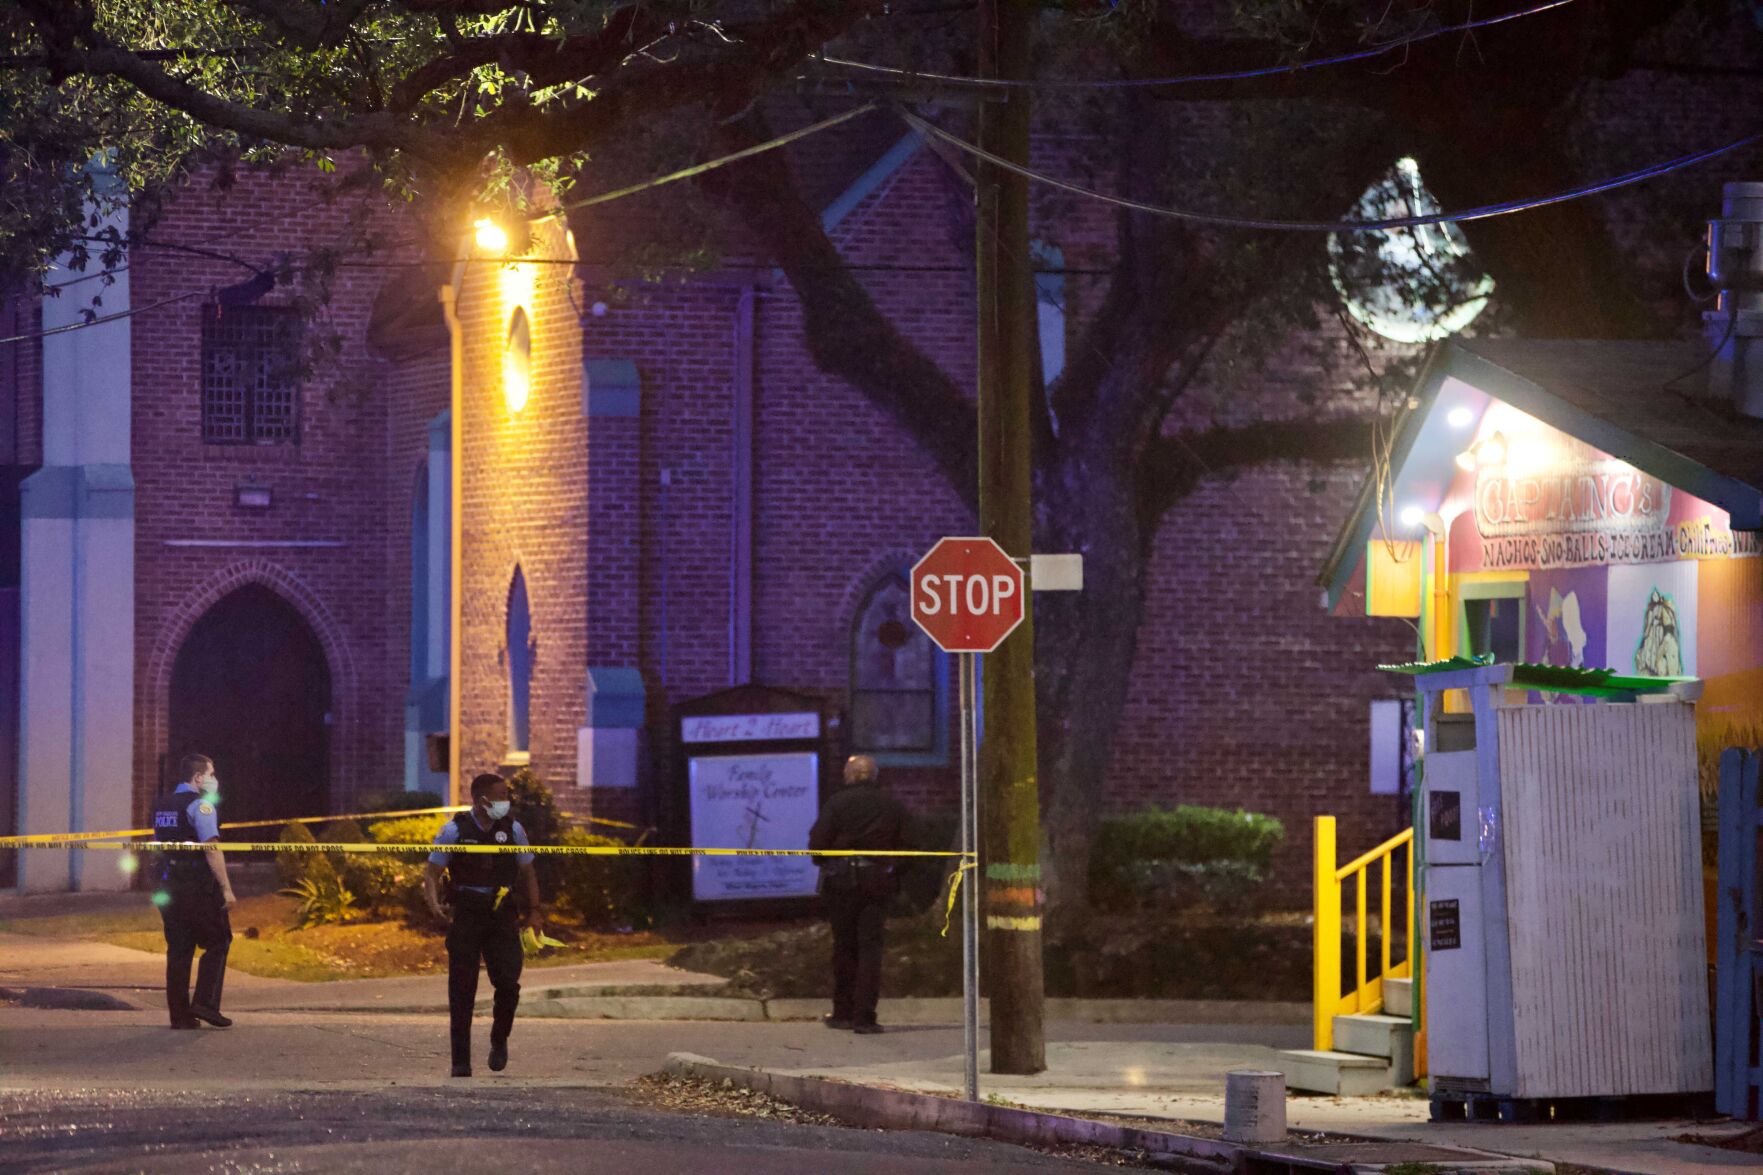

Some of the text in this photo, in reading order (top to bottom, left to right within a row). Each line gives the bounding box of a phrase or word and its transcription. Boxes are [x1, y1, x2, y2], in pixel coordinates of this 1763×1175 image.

[1483, 539, 1538, 568] NACHOS
[1565, 533, 1606, 563] BALLS
[1632, 530, 1676, 559] CREAM
[919, 574, 1015, 616] STOP
[155, 816, 178, 827] POLICE
